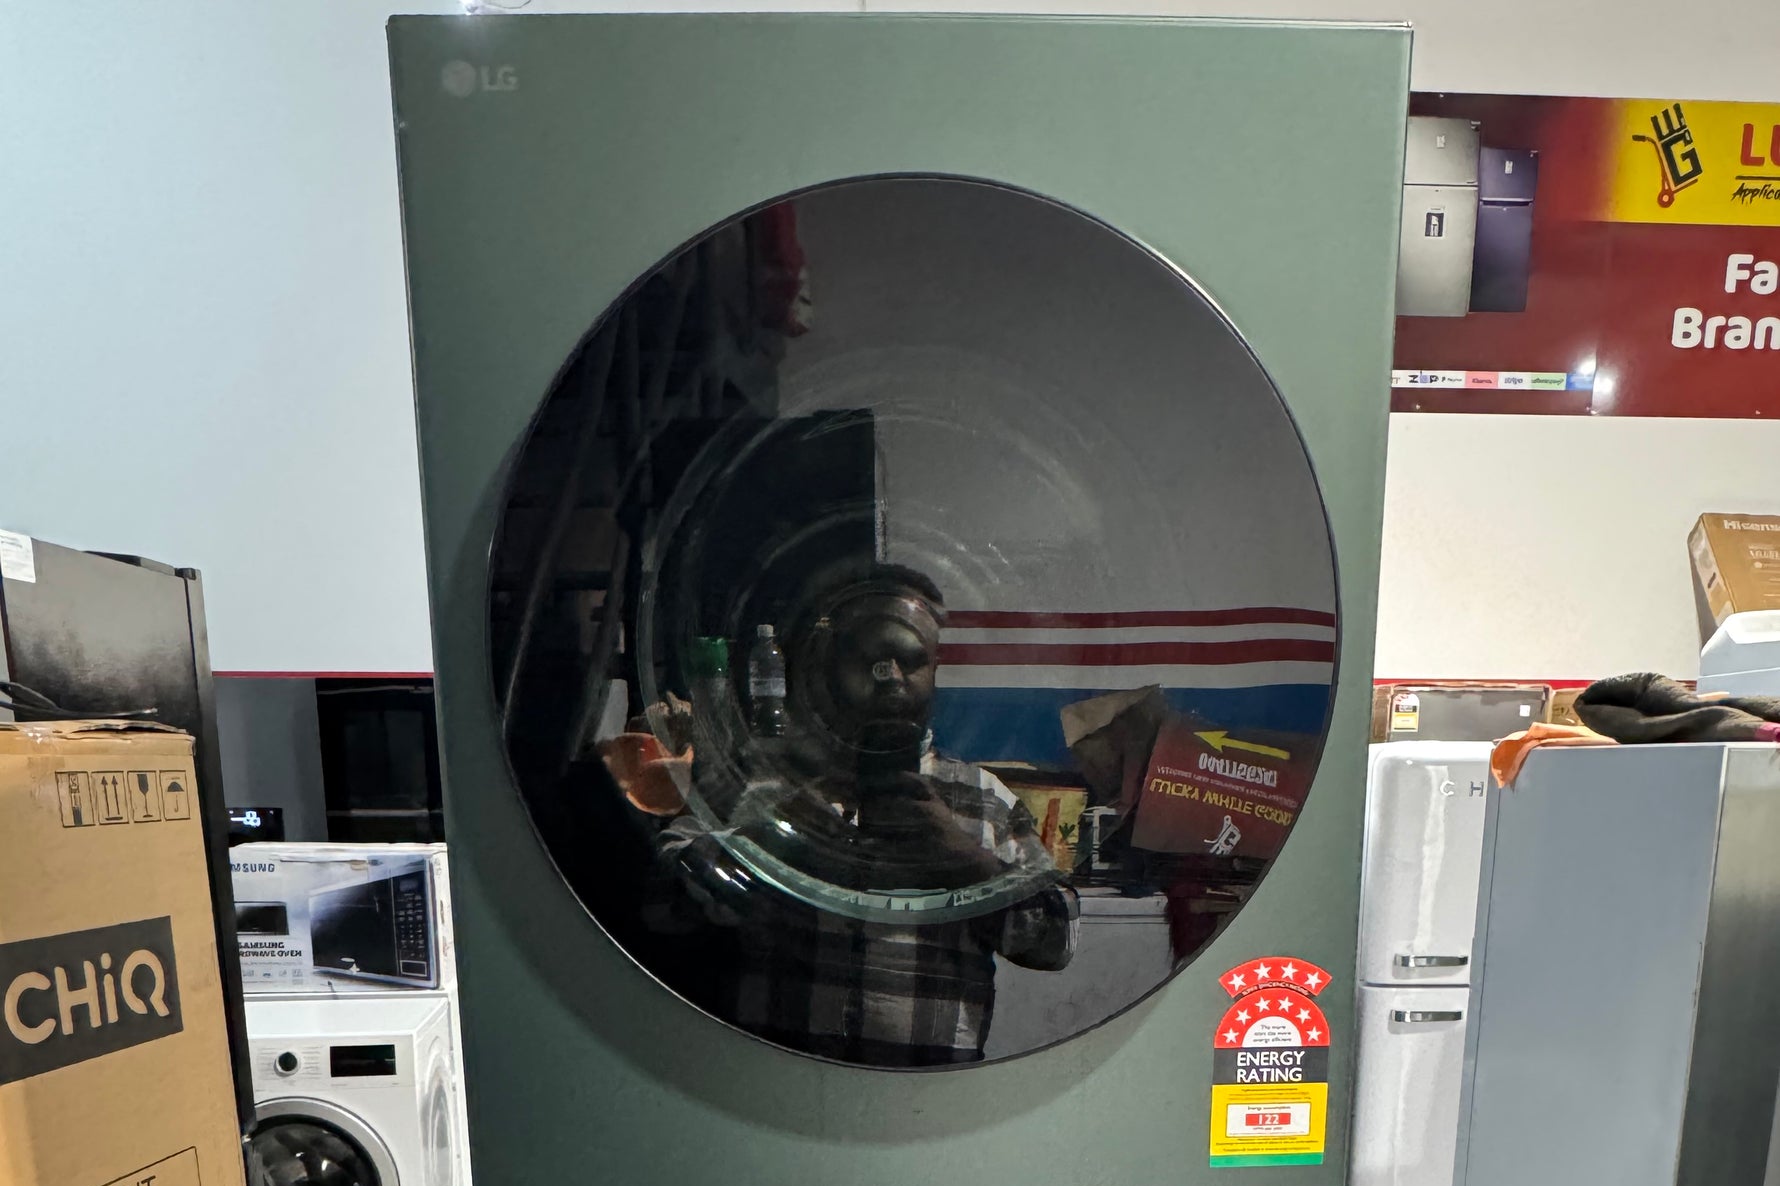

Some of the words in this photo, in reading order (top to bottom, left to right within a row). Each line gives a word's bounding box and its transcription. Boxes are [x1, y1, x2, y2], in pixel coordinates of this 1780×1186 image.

[480, 64, 519, 91] LG
[1723, 253, 1780, 296] Fa
[1671, 306, 1780, 350] Bran
[231, 863, 276, 873] MSUNG
[4, 948, 171, 1045] CHiQ
[1237, 1050, 1306, 1067] ENERGY
[1236, 1067, 1303, 1083] RATING
